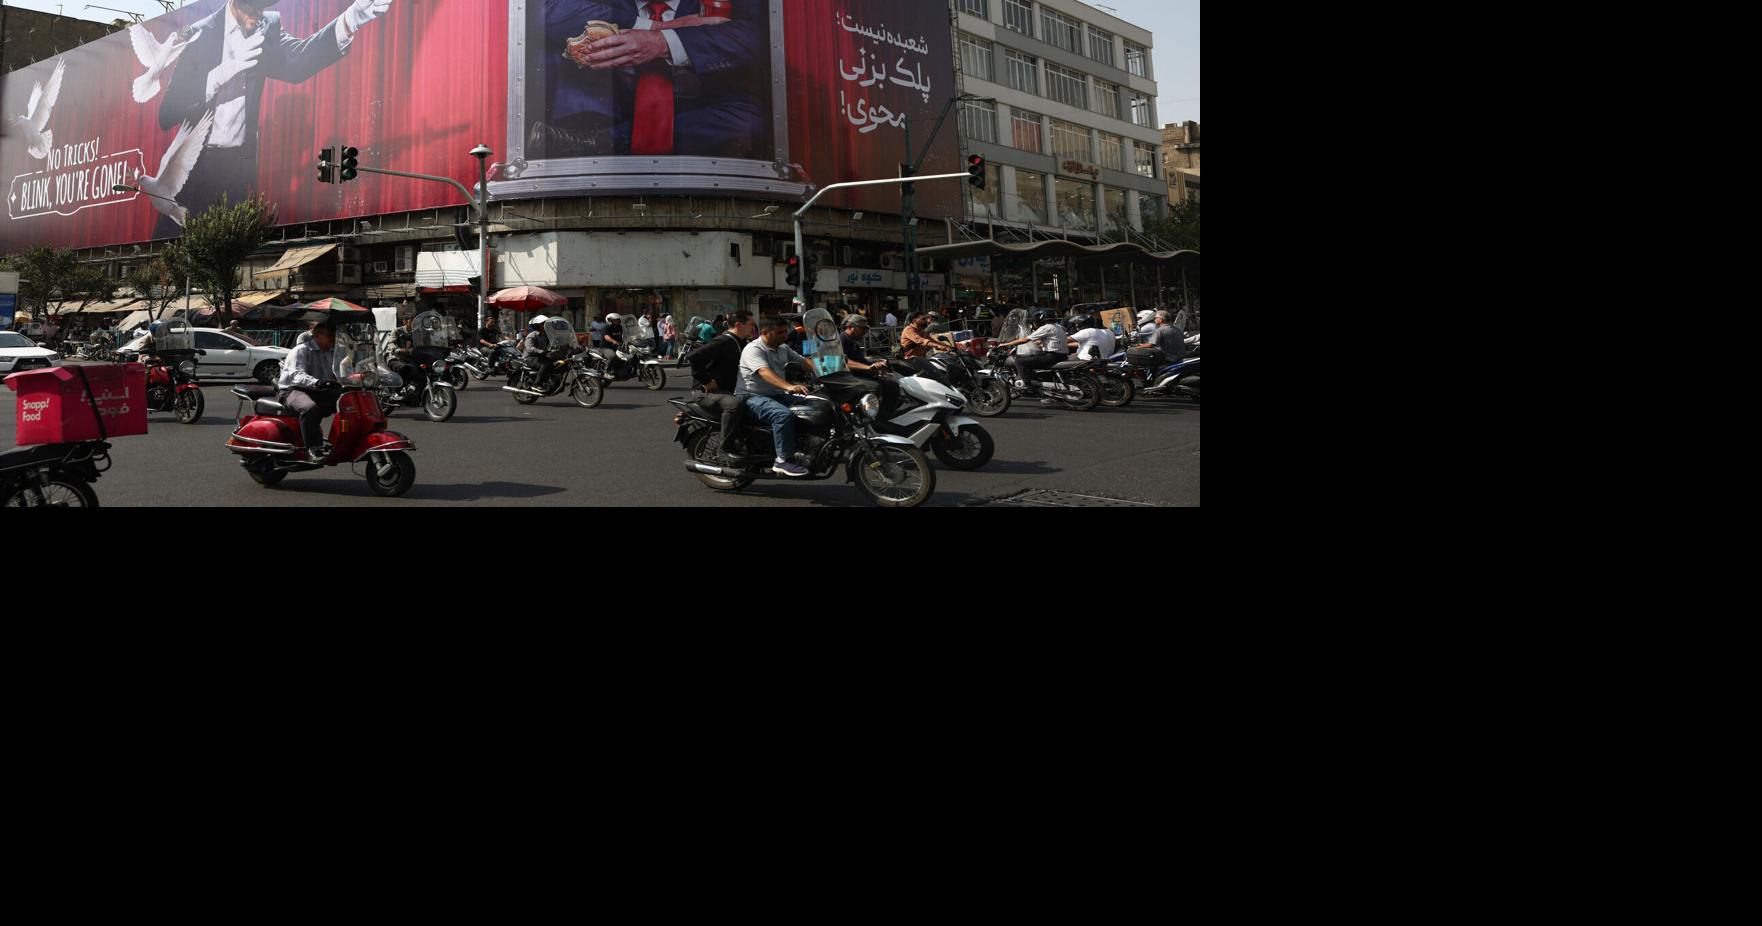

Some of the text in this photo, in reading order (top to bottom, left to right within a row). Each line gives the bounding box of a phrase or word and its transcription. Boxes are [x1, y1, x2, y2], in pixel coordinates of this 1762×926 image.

[886, 31, 929, 55] شعبده
[840, 47, 931, 104] پلک بزنی
[841, 90, 906, 134] محوی!
[46, 137, 100, 172] NO TRICKS!
[20, 160, 128, 212] BLINK, YOU'RE GONE!
[23, 398, 50, 410] Snapp!
[23, 411, 42, 422] Food
